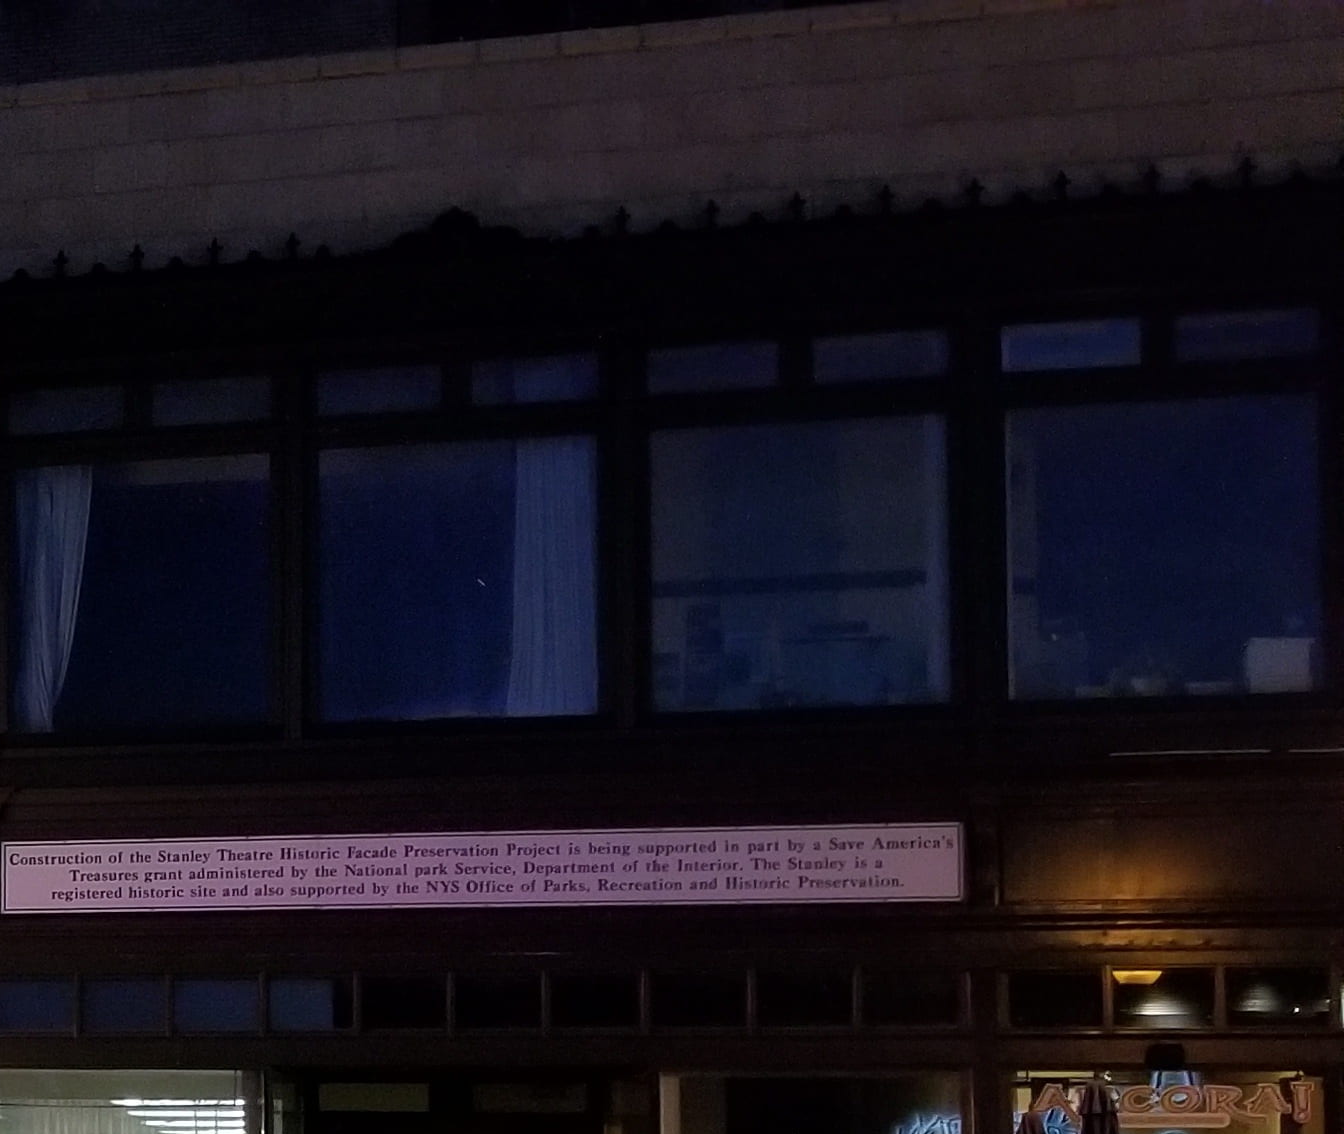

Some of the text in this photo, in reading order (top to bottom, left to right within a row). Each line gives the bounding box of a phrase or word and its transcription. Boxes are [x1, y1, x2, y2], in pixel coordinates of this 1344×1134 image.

[9, 835, 955, 867] Construction of the Stanley Theatre Historic Facade Preservation Project is being supported in part by a Save America's
[69, 856, 883, 883] Treasures grant administered by the National park Service, Department of the Interior. The Stanley is a
[51, 874, 905, 901] registered historic site and also supported by the NYS Office of Parks, Recreation and Historic Preservation.
[1029, 1083, 1314, 1124] ACORA!
